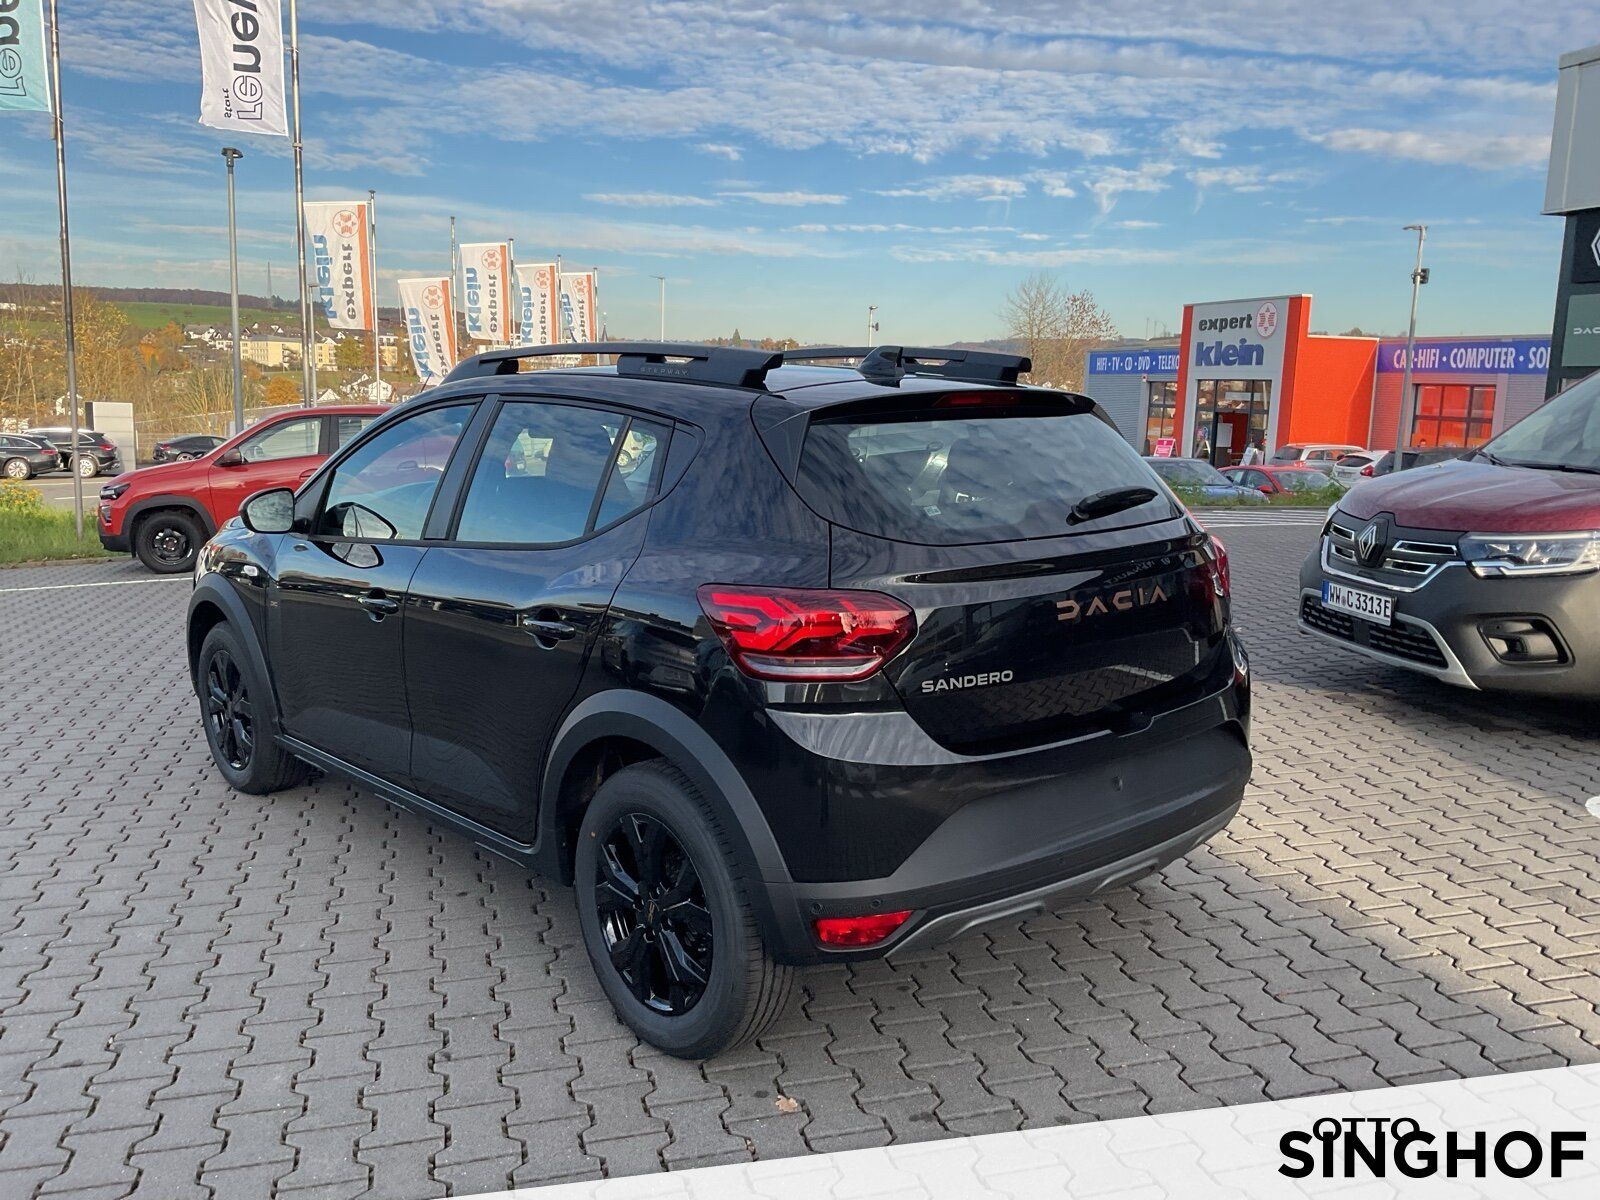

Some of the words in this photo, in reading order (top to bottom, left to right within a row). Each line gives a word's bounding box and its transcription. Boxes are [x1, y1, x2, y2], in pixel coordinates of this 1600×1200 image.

[1198, 312, 1252, 332] expert
[1112, 356, 1120, 371] TV
[1124, 356, 1133, 371] CD
[1137, 355, 1151, 371] DVD
[1195, 338, 1265, 367] klein
[1450, 347, 1516, 369] COMPUTER
[641, 367, 689, 376] STEPWAY
[1056, 585, 1168, 621] DACIA
[921, 670, 1013, 693] SANDERO
